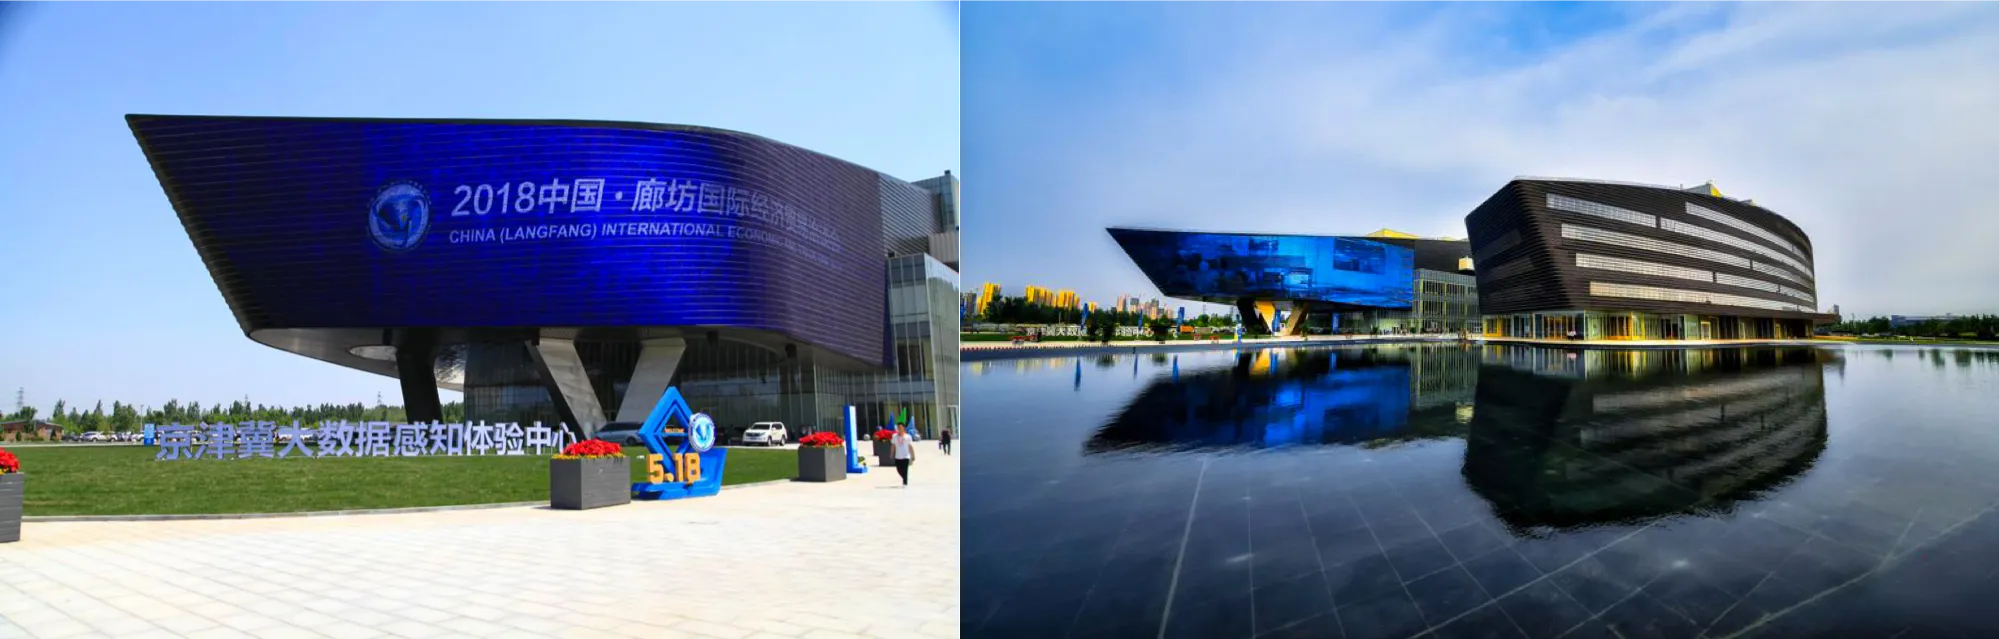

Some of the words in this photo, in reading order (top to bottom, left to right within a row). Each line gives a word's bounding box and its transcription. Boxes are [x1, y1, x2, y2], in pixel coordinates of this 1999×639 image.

[449, 228, 496, 244] CHINA
[500, 222, 597, 244] (LANGFANG)
[601, 222, 725, 238] INTERNATIONAL
[155, 418, 577, 461] 京津冀大数据感知体验中心
[646, 452, 701, 485] 5.18
